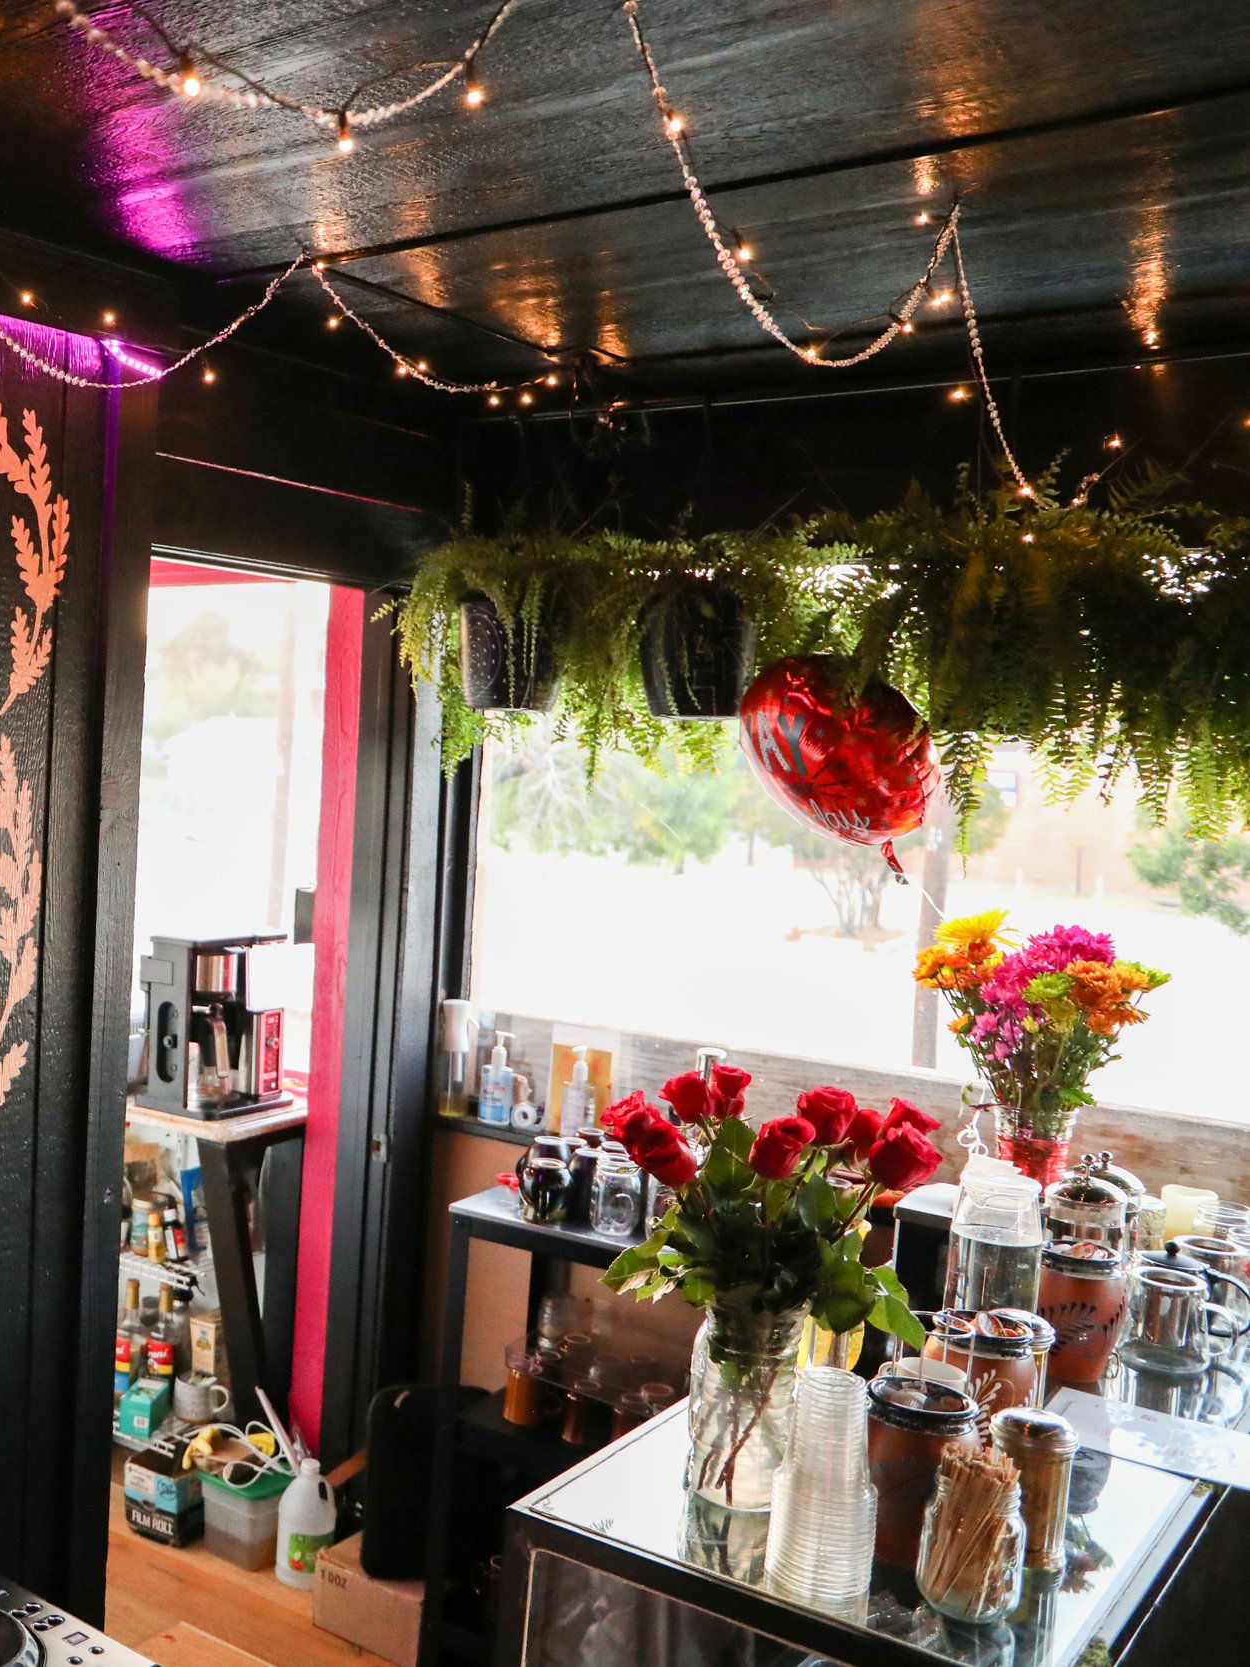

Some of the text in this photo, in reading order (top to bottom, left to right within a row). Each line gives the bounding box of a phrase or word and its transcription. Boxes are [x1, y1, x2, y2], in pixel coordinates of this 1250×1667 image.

[746, 711, 807, 776] AY
[131, 1508, 151, 1530] FILM
[152, 1517, 174, 1536] ROLL
